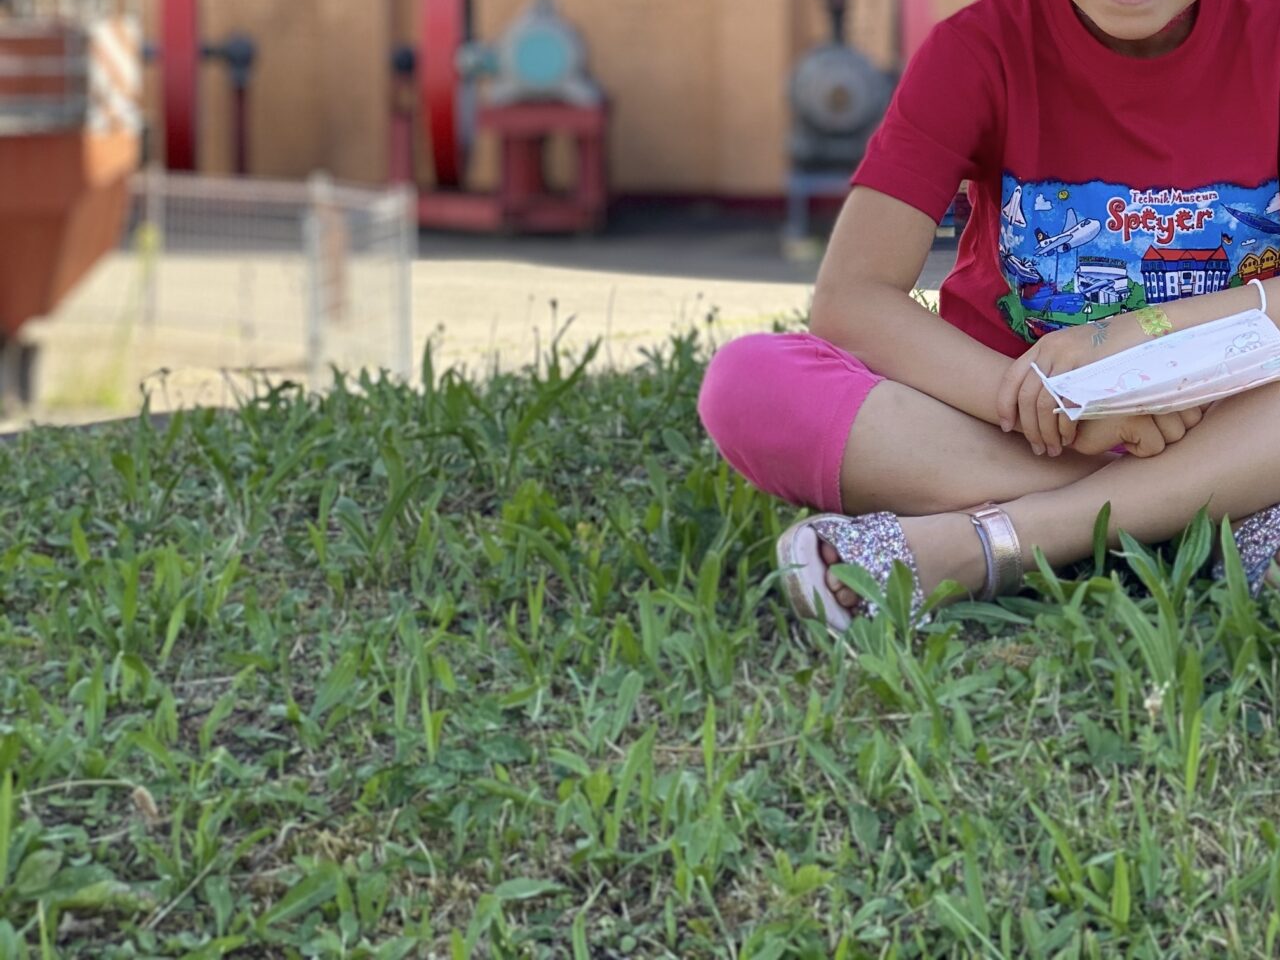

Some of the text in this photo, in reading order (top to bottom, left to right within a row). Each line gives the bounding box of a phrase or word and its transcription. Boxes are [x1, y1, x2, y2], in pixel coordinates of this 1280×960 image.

[1131, 190, 1218, 204] Technik Museum
[1107, 198, 1213, 244] Speyer
